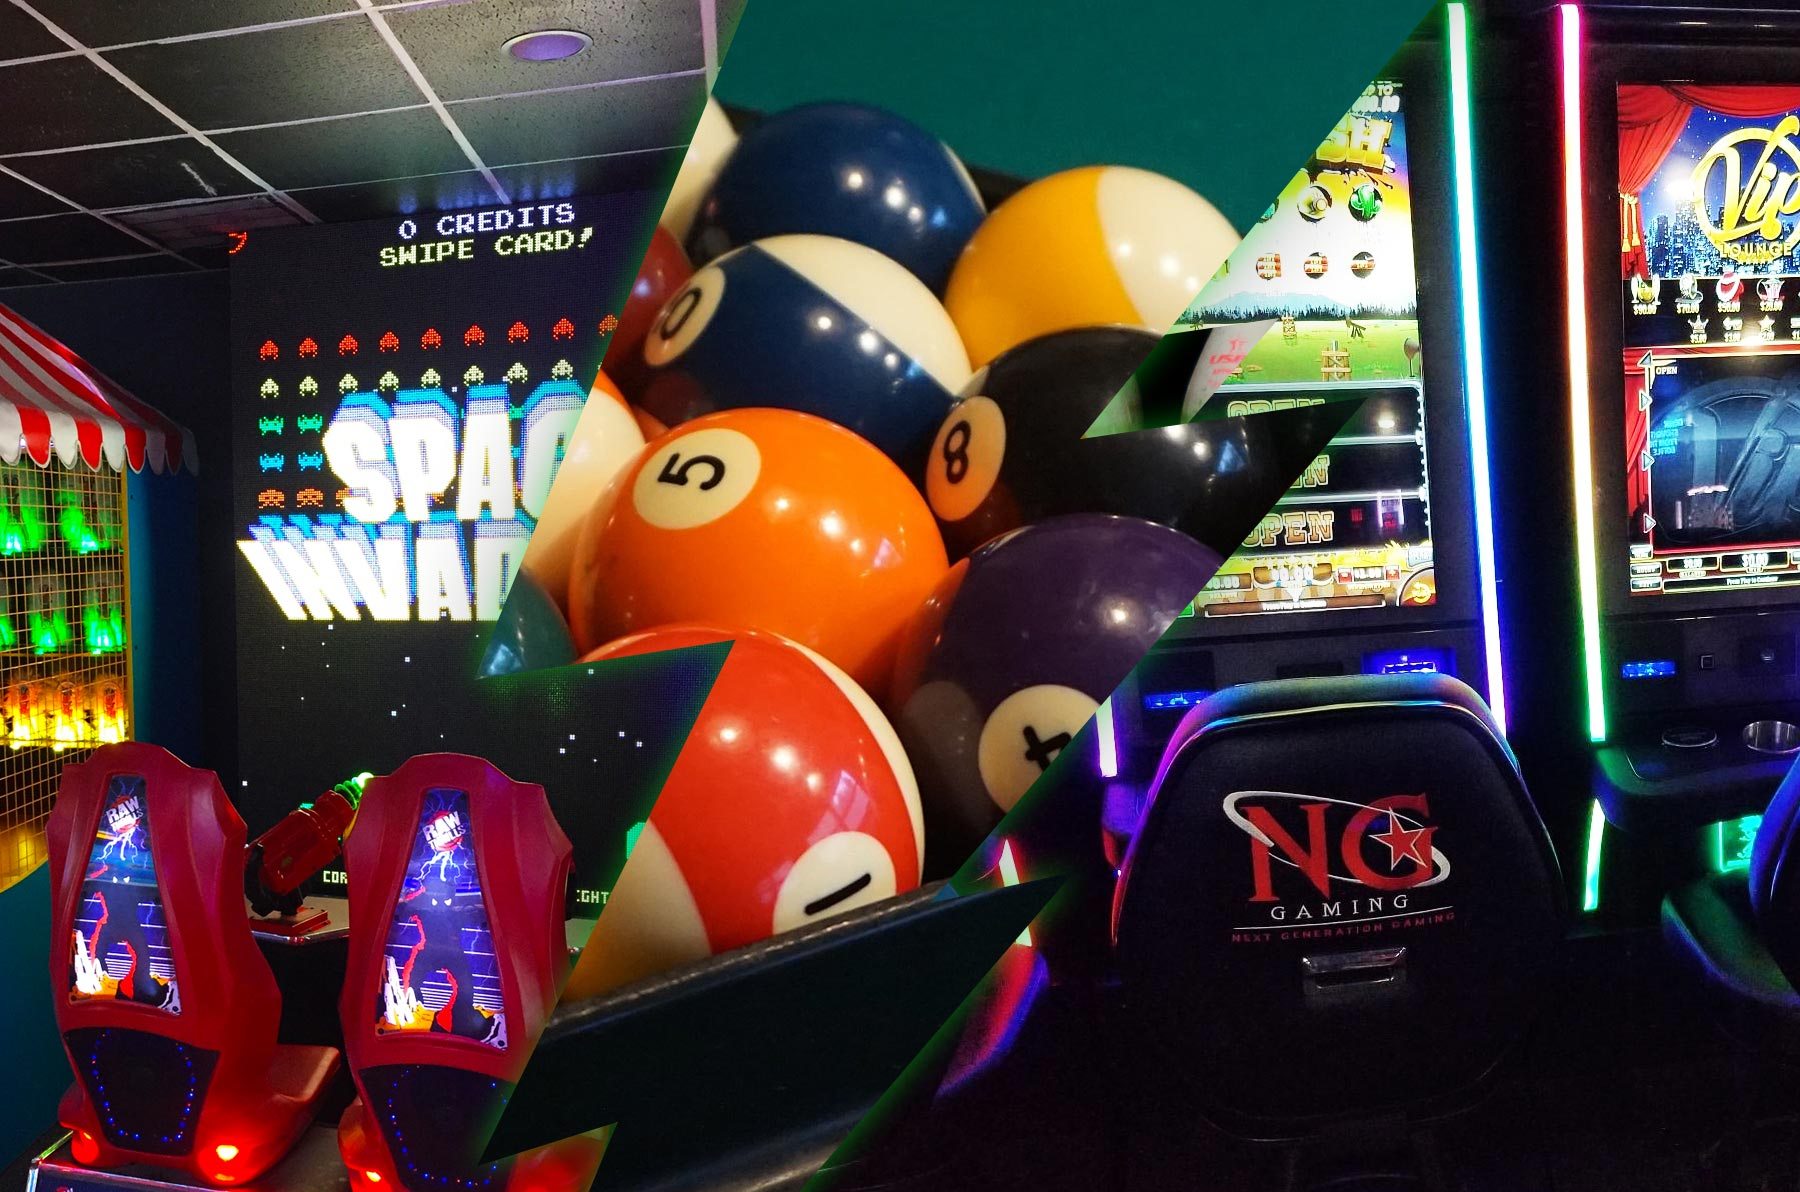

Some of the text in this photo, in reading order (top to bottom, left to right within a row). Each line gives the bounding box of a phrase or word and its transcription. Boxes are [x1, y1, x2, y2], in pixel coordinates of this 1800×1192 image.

[436, 203, 576, 236] CREDITS
[380, 227, 593, 267] SWIPE CARD!
[1720, 241, 1792, 258] LOUNGE
[1655, 366, 1678, 375] OPEN
[944, 420, 973, 485] 8
[657, 452, 726, 491] 5
[106, 796, 140, 824] RAW
[423, 811, 461, 841] RAW
[1239, 792, 1438, 902] NG
[1271, 894, 1409, 920] GAMING
[1232, 911, 1456, 943] NEXT GENERATION GAMING
